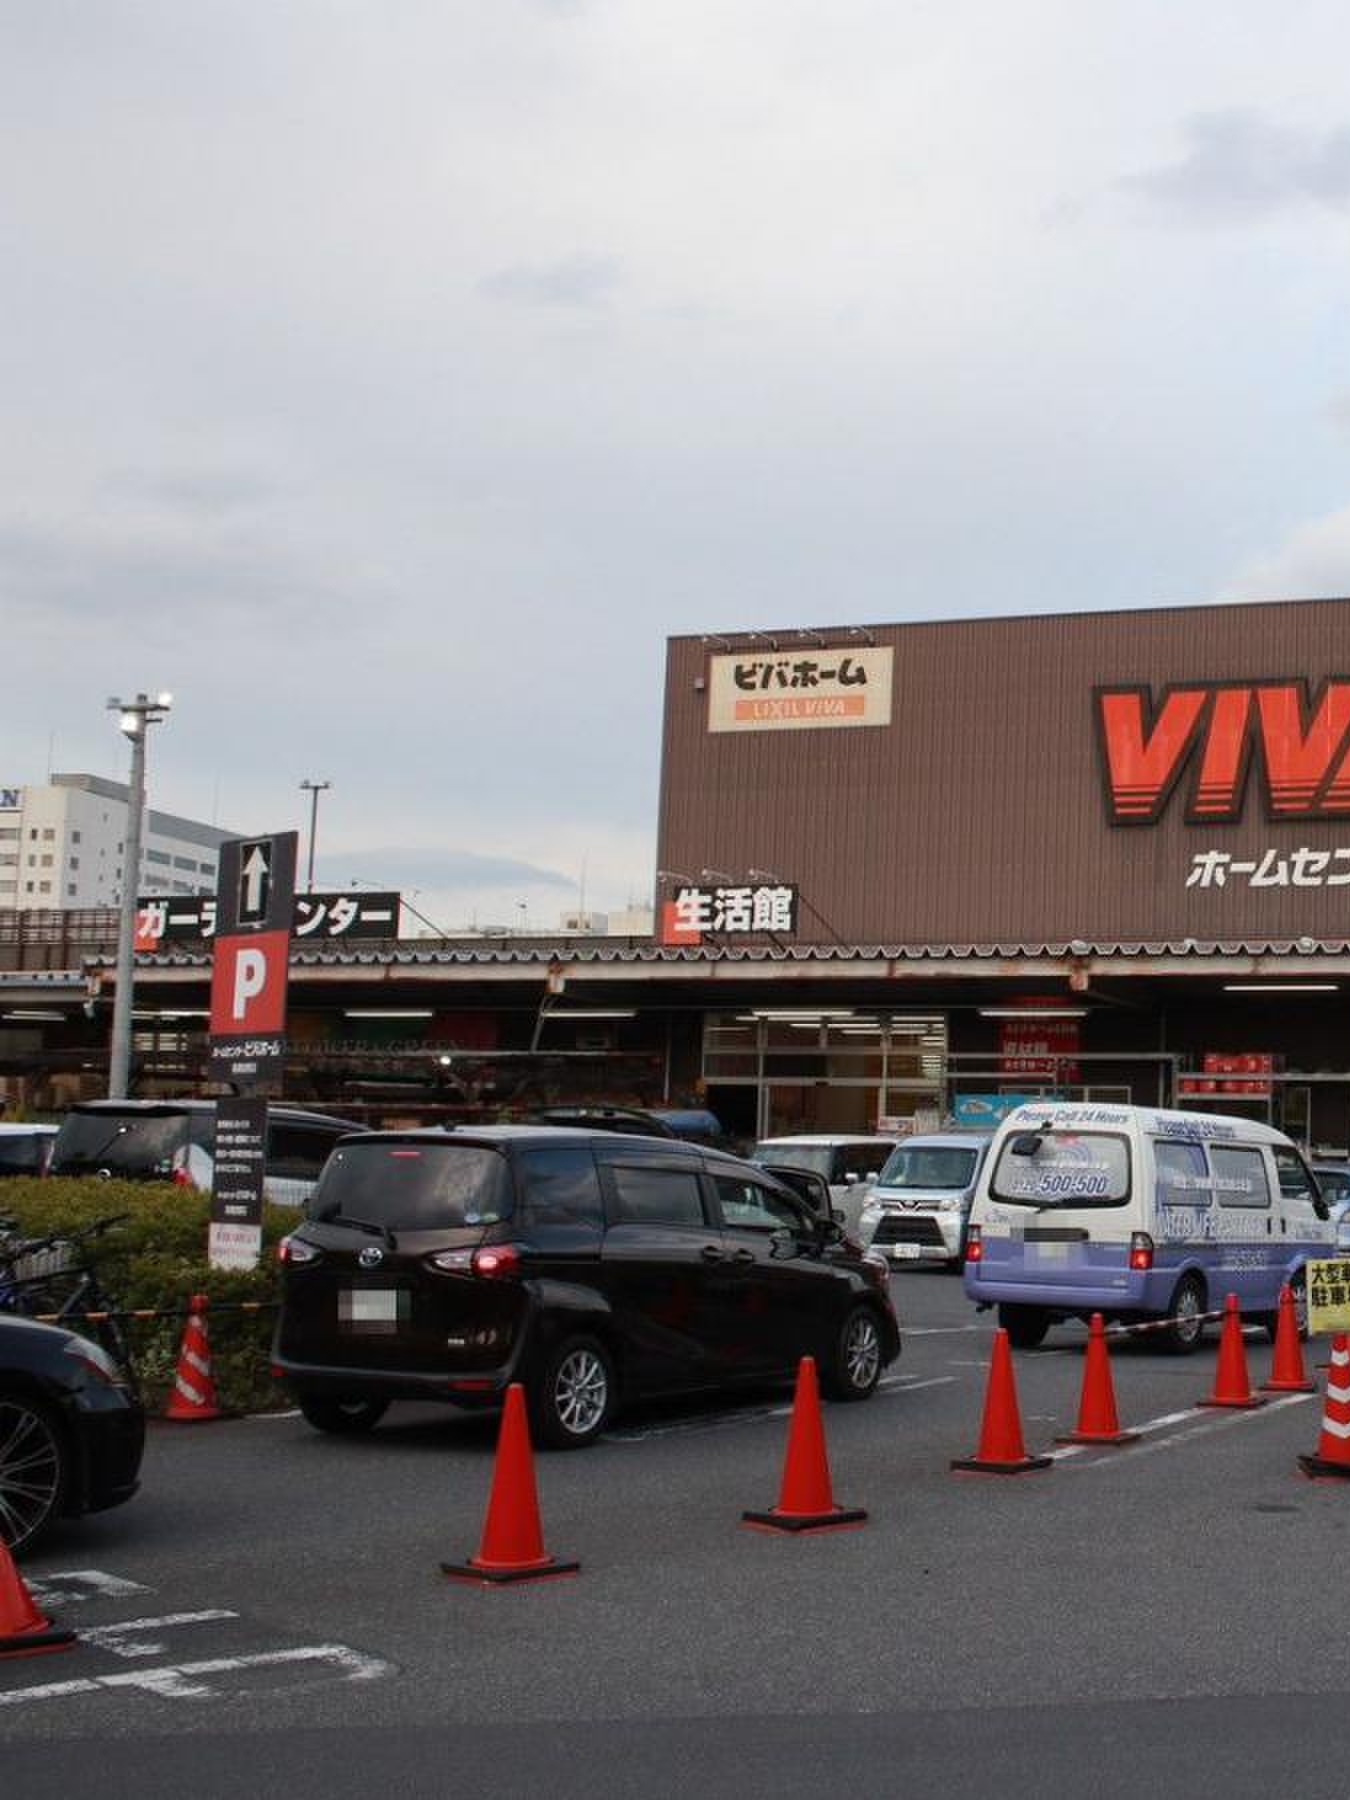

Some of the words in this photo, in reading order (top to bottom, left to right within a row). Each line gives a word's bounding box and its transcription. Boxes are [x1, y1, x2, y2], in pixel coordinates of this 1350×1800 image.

[734, 658, 867, 690] ビバホーム
[675, 887, 792, 932] 生活館
[234, 948, 267, 1018] P
